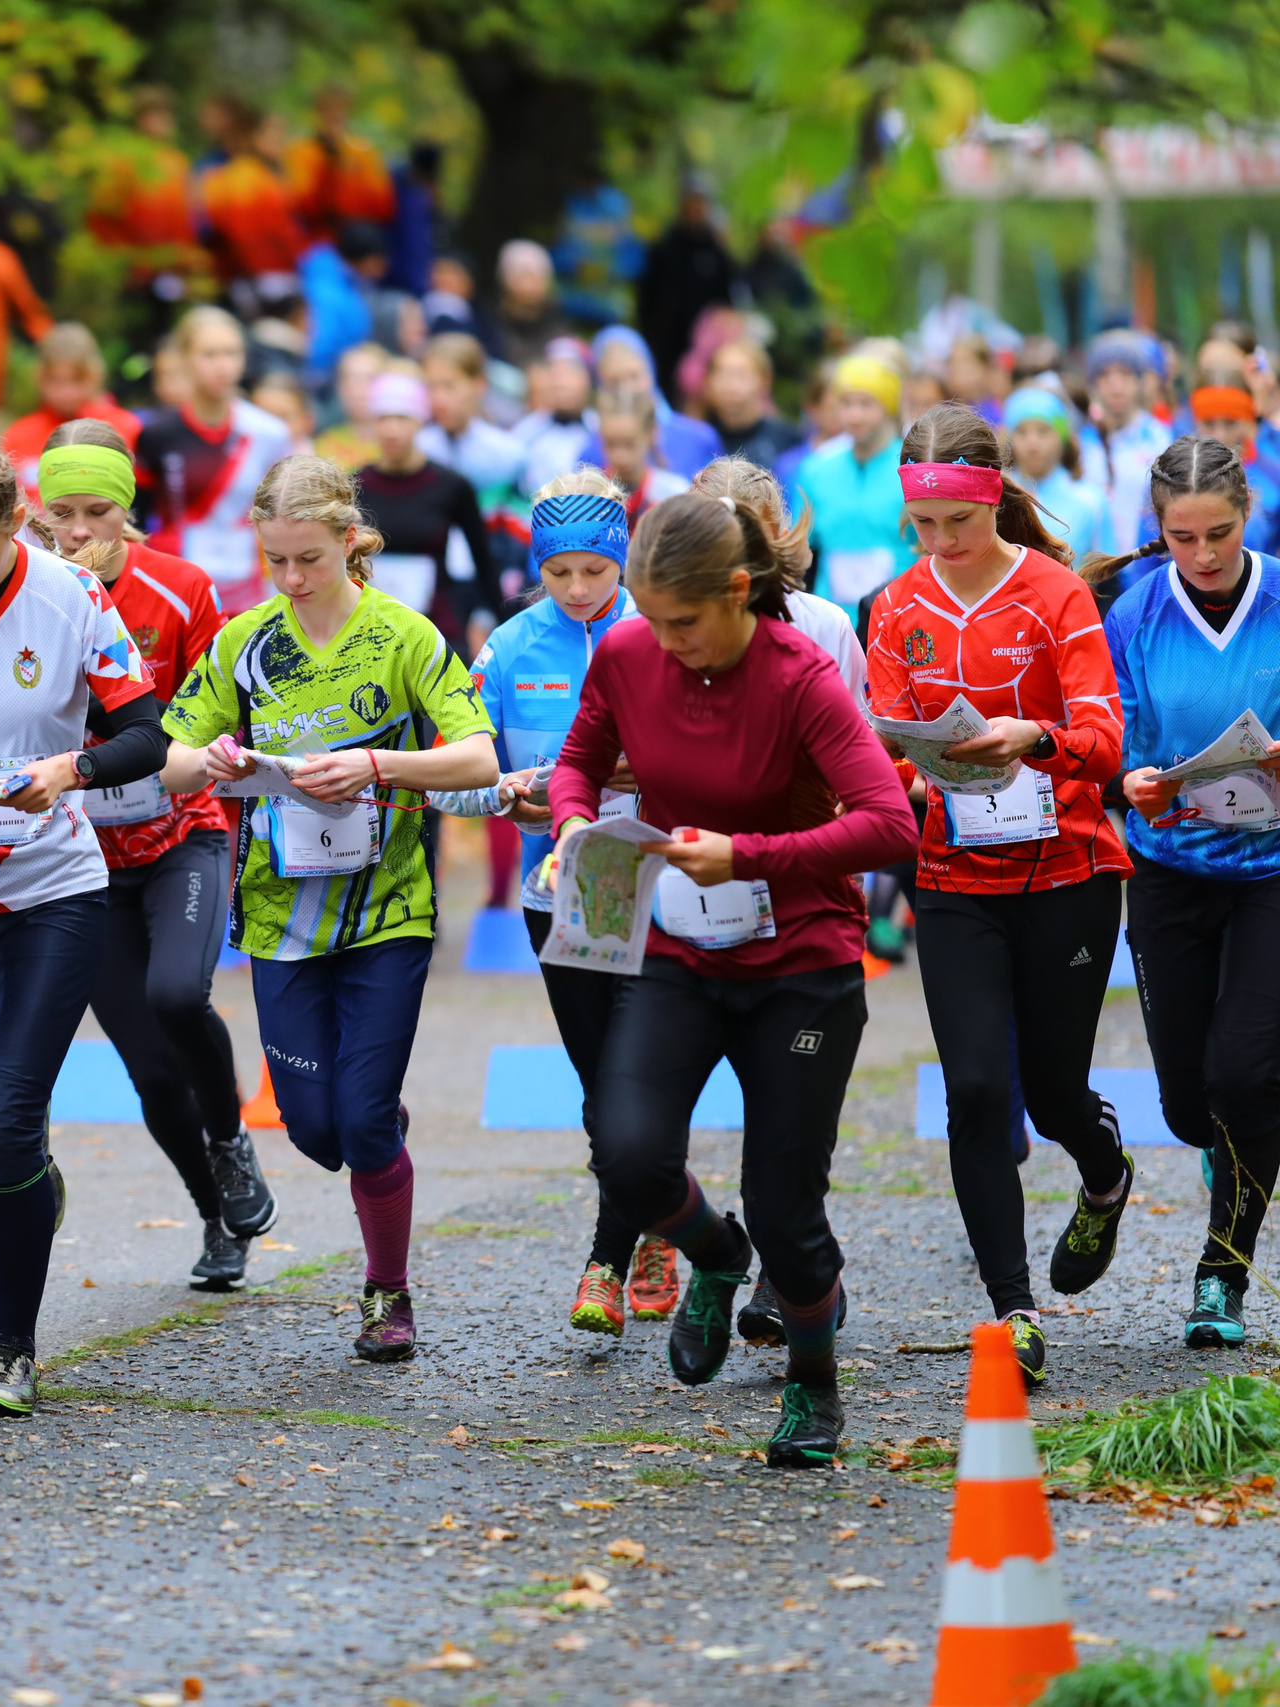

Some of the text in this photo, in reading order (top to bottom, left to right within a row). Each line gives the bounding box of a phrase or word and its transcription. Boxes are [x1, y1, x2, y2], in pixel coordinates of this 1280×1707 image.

[991, 641, 1048, 656] ORIENTEERING
[1011, 656, 1035, 665] TEAM
[101, 787, 124, 801] 10
[1224, 790, 1237, 807] 2
[985, 794, 997, 813] 3
[1238, 807, 1265, 815] линия
[994, 816, 998, 824] 1
[1001, 814, 1028, 823] линия
[320, 829, 332, 848] 6
[328, 850, 332, 858] 1
[334, 849, 362, 859] линия
[699, 894, 708, 914] 1
[1069, 956, 1093, 967] adidas
